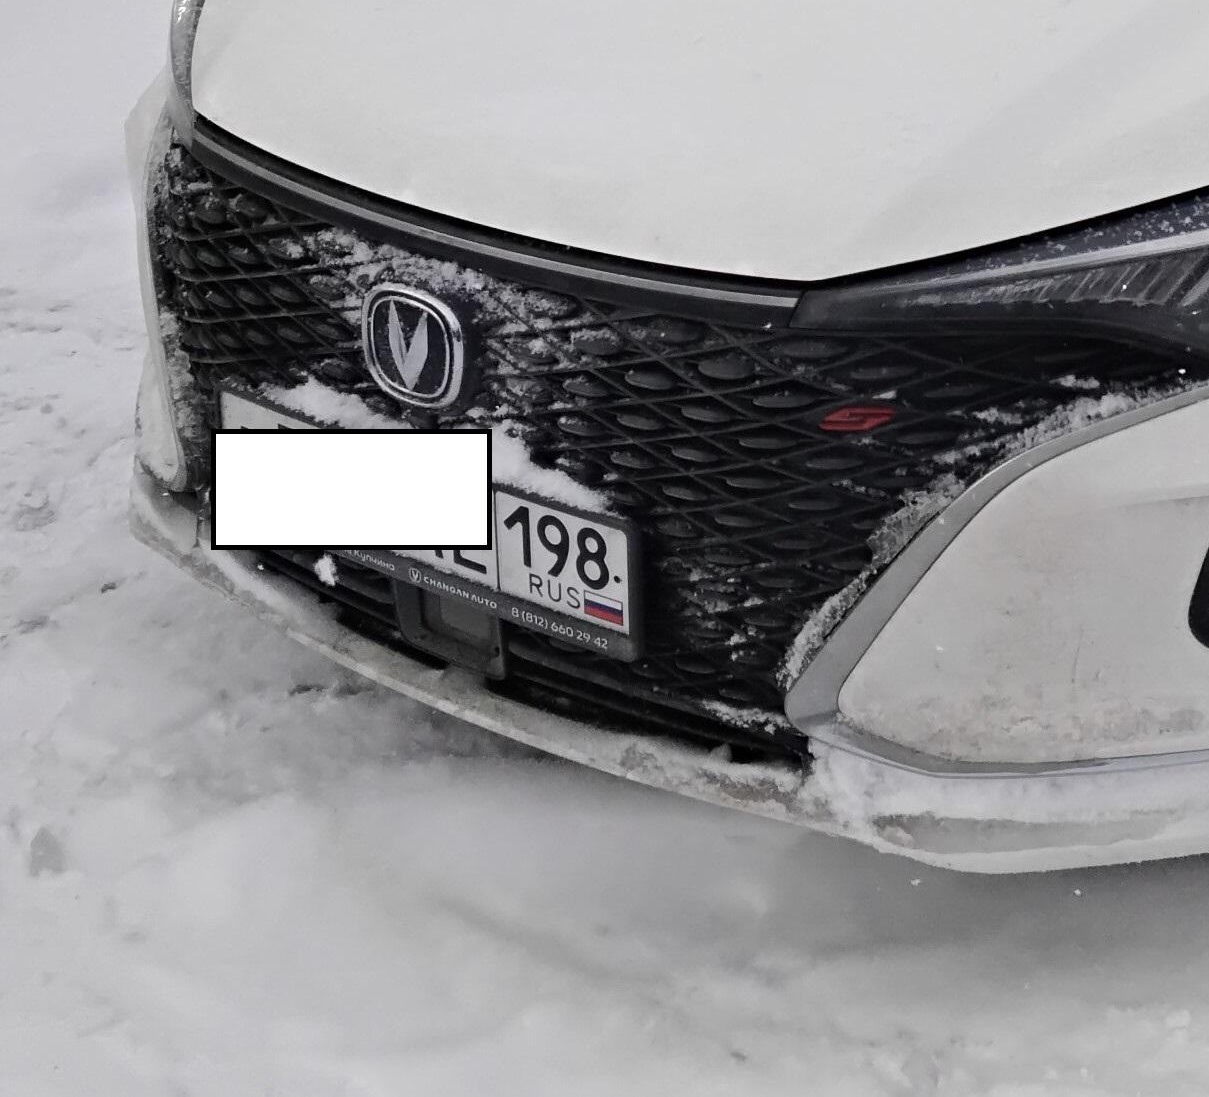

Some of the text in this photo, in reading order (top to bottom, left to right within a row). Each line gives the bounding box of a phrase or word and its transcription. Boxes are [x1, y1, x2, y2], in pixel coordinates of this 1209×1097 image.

[503, 505, 610, 591] 198
[423, 576, 498, 609] CHANGAN AUTO
[528, 572, 581, 609] RUS
[511, 606, 608, 650] 8 (812) 660 29 42
